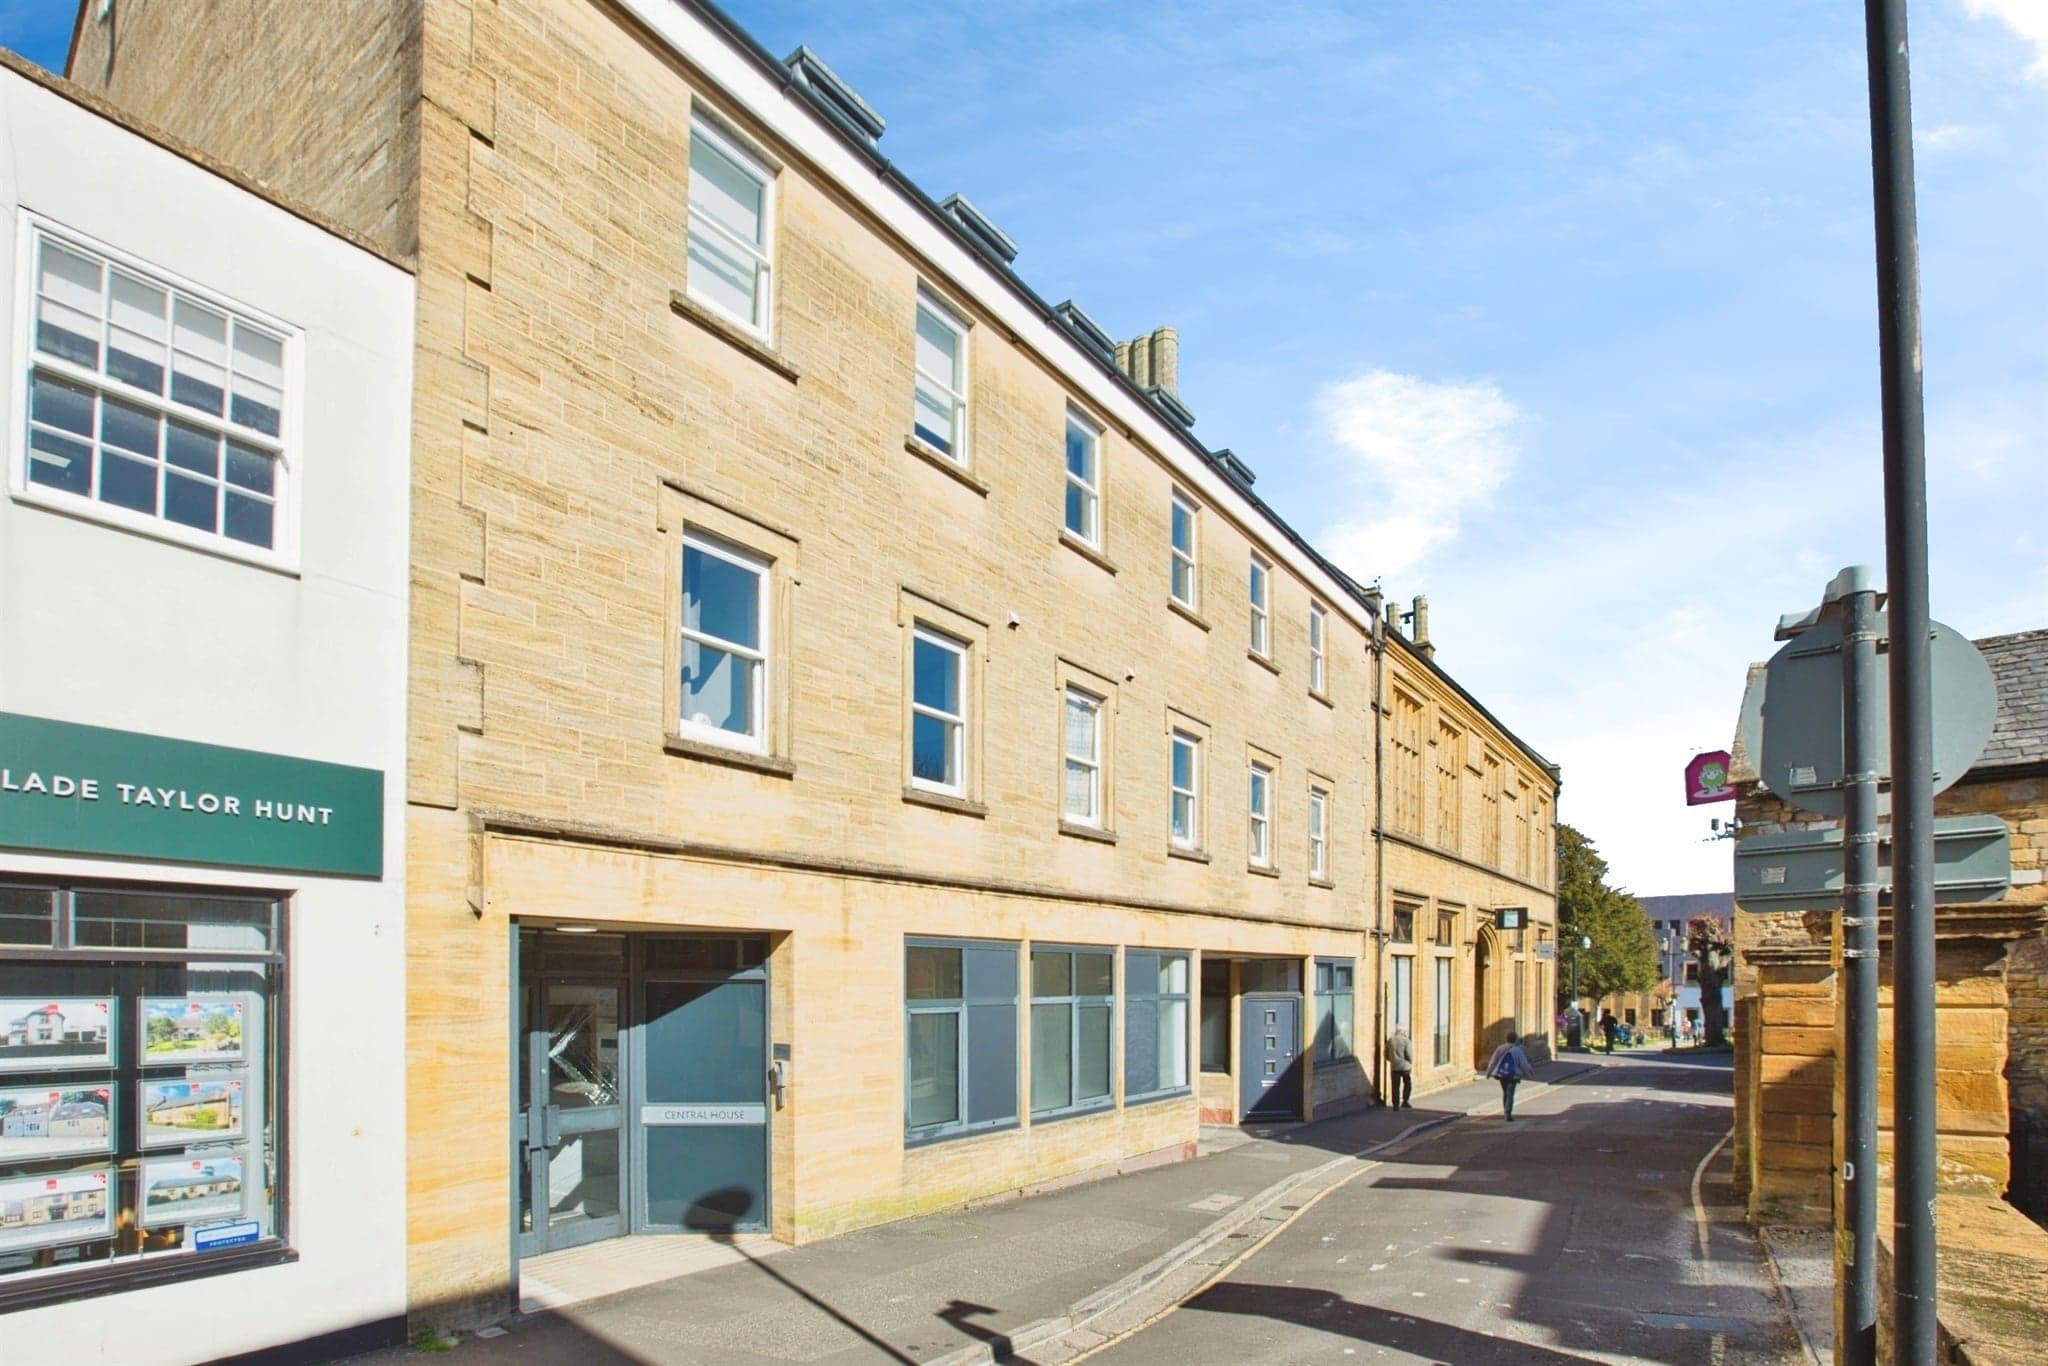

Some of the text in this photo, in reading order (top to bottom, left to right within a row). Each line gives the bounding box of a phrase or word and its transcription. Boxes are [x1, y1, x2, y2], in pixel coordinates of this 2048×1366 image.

[1, 768, 333, 826] LADE TAYLOR HUNT
[664, 1110, 745, 1120] CENTRAL HOUSE
